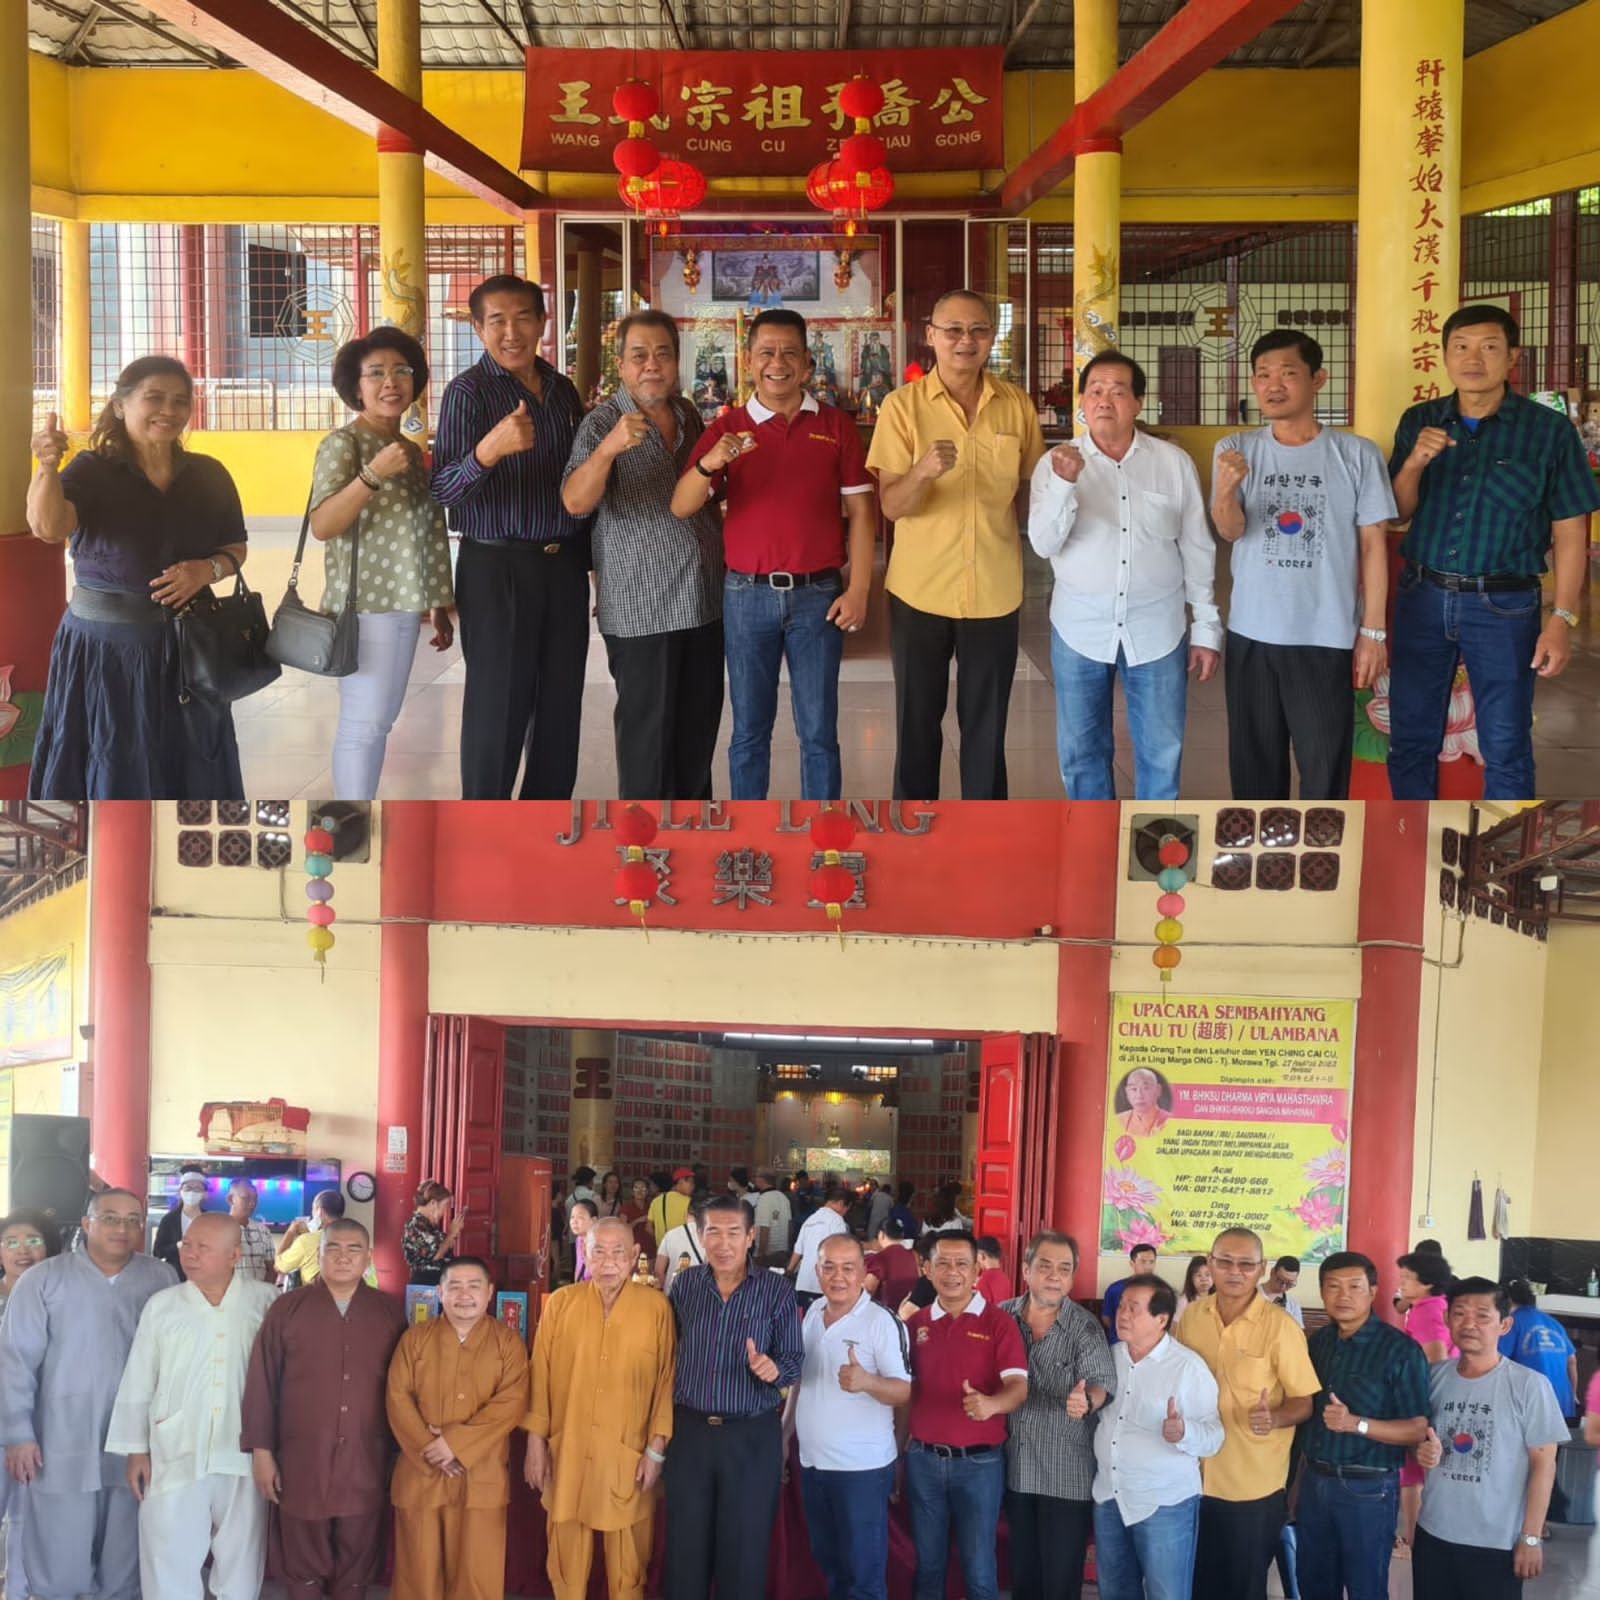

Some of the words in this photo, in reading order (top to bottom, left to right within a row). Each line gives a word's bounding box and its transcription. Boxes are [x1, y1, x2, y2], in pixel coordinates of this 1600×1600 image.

[551, 132, 600, 148] WANG
[686, 138, 732, 152] CUNG
[761, 139, 786, 152] CU
[879, 134, 911, 149] IAU
[935, 130, 982, 147] GONG
[1264, 473, 1323, 489] 대한민국
[1278, 559, 1313, 569] KOREA
[775, 800, 936, 836] LNG
[1133, 1002, 1209, 1019] UPACARA
[1214, 1004, 1326, 1022] SEMBAHYANG
[1118, 1021, 1163, 1038] CHAU
[1168, 1023, 1188, 1038] TU
[1192, 1021, 1233, 1041] (超度)
[1238, 1024, 1245, 1041] /
[1250, 1026, 1340, 1042] ULAMBANA
[1148, 1056, 1166, 1065] Ling
[1194, 1057, 1213, 1065] ONG
[1150, 1045, 1175, 1056] Orang
[1193, 1047, 1208, 1055] dan
[1259, 1048, 1277, 1057] YEN
[1278, 1049, 1306, 1058] CHING
[1307, 1049, 1322, 1058] CAI
